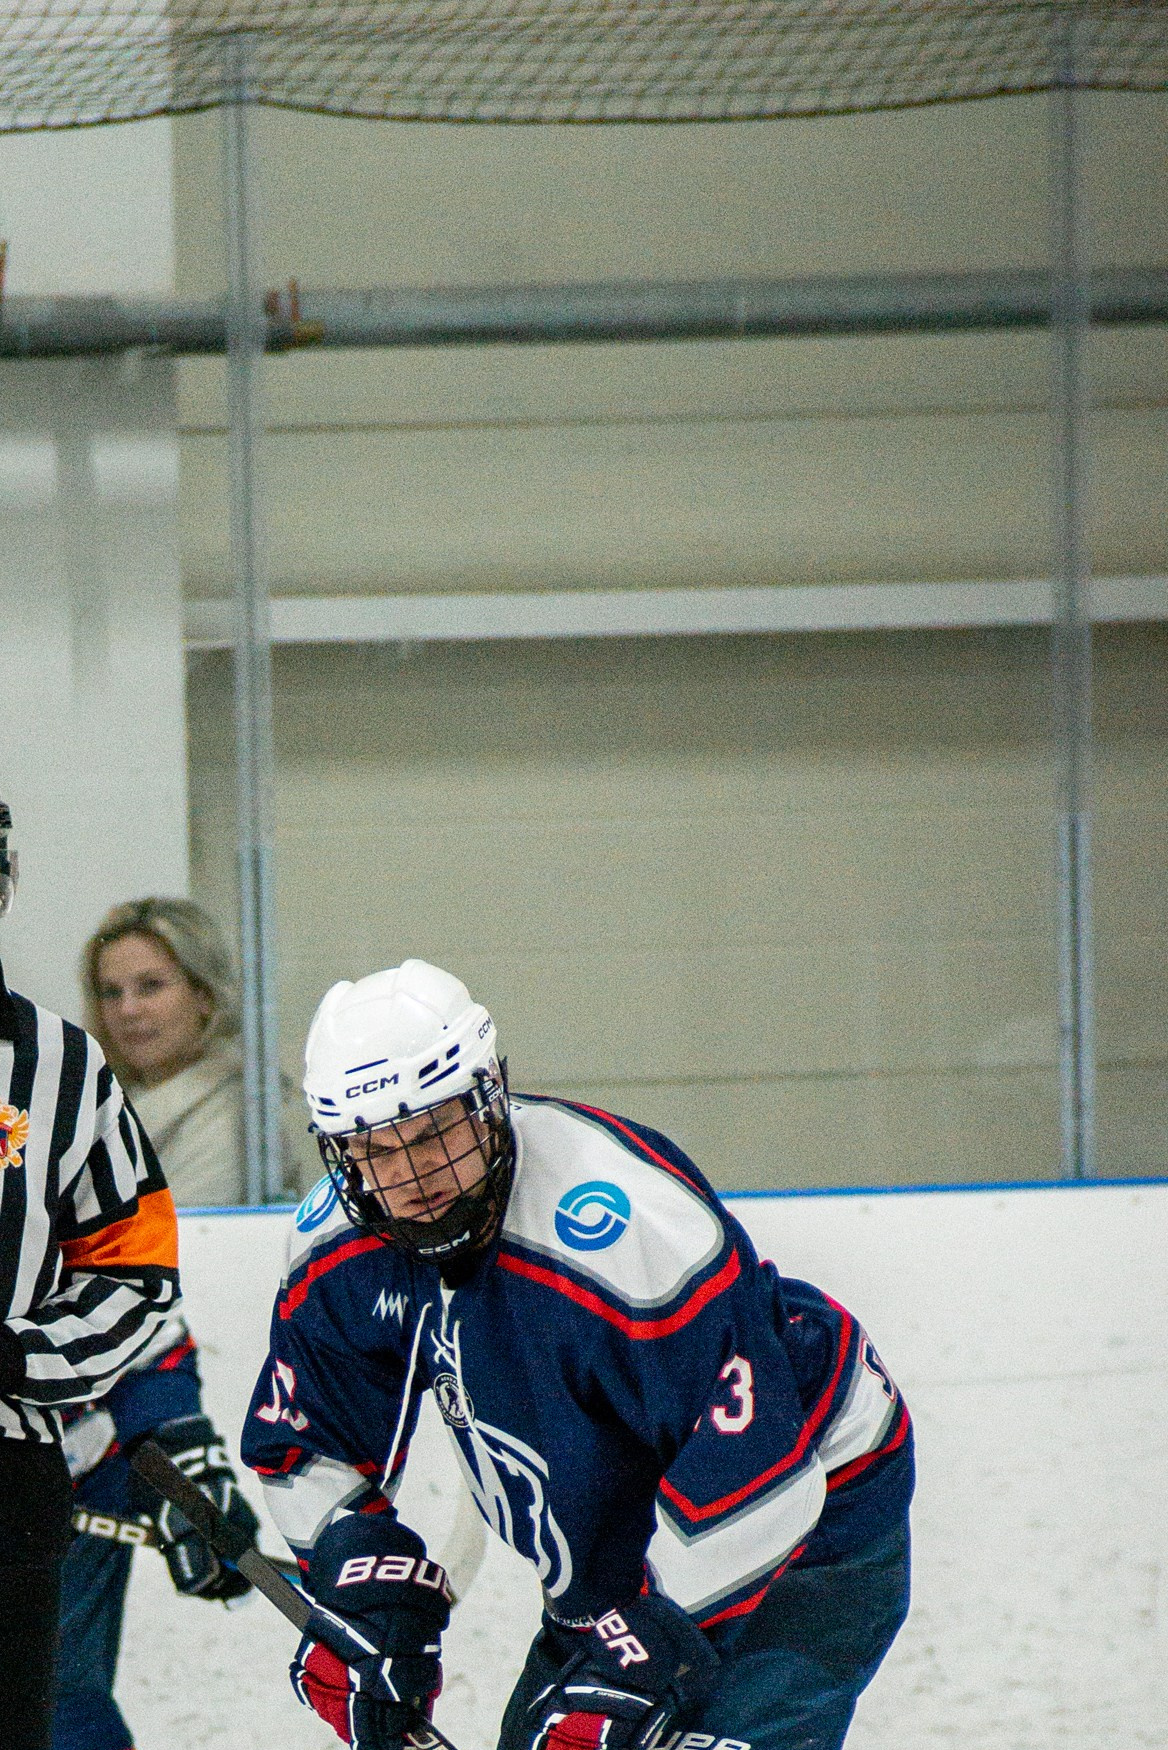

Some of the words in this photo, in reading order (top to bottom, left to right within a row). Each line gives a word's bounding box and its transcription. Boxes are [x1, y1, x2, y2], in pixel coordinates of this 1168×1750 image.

[477, 1015, 493, 1040] CCM
[345, 1072, 400, 1099] CCM
[418, 1229, 471, 1254] CCM
[335, 1555, 448, 1593] BAU
[595, 1608, 650, 1669] ER
